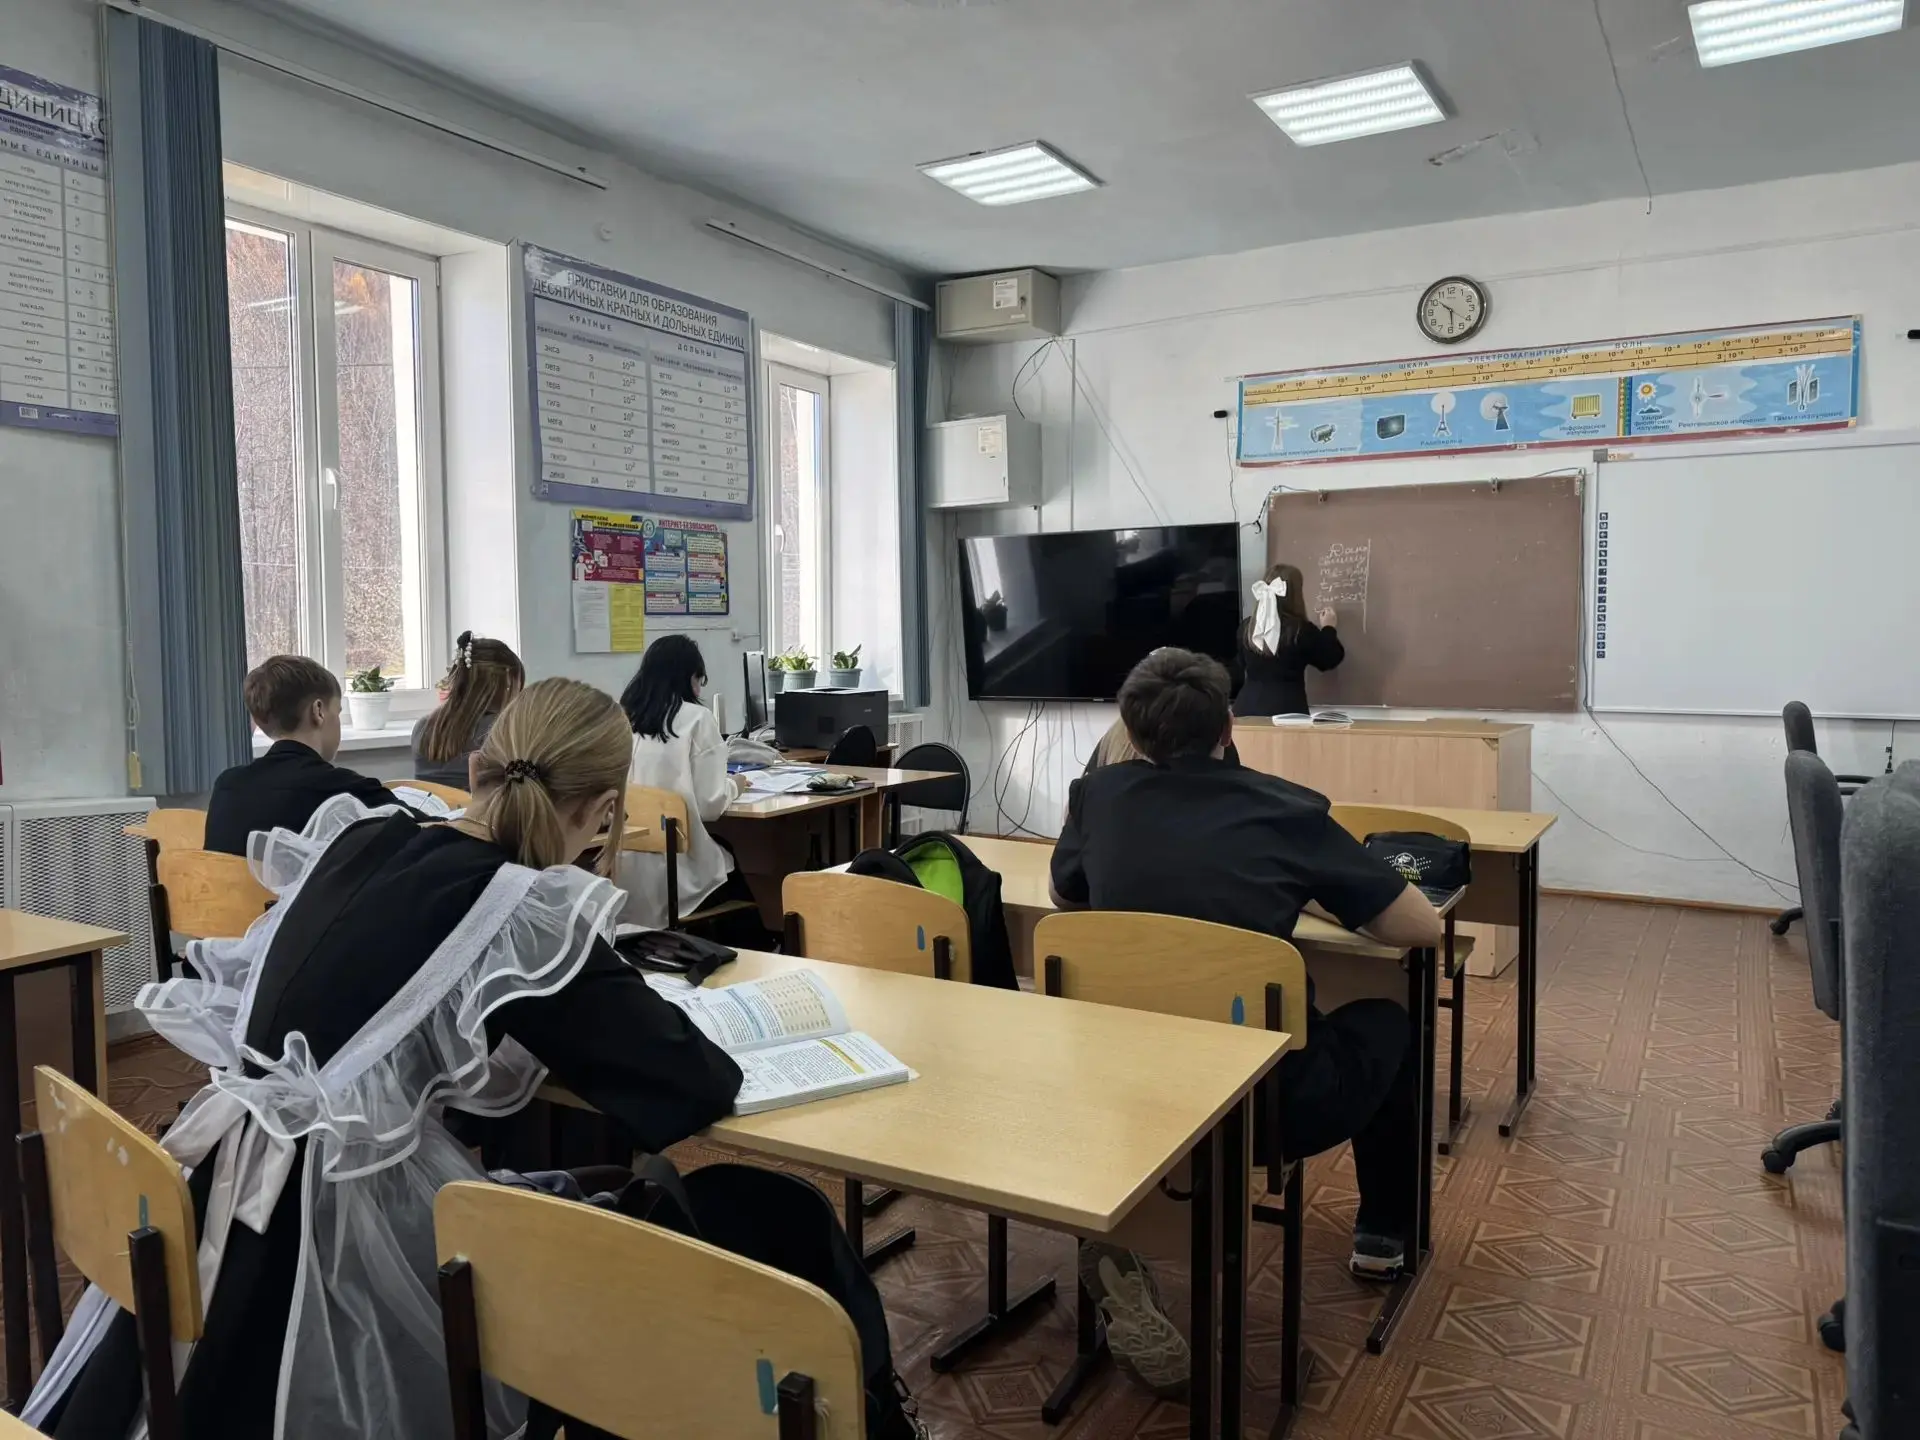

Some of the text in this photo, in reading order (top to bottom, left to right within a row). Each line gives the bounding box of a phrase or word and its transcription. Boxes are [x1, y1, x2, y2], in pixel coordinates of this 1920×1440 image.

[567, 271, 718, 327] ПРИСТАВКИ ДЛЯ ОБРАЗОВАНИЯ
[1438, 291, 1445, 299] 11
[1466, 295, 1472, 303] 2
[532, 278, 745, 350] ДЕСЯТИЧНЫХ КРАТНЫХ И ДОЛЬНЫХ ЕДИНИЦ
[1469, 304, 1475, 312] 3
[569, 313, 613, 332] КРАТНЫЕ
[1458, 322, 1465, 330] 5
[1398, 340, 1642, 369] ШКАЛА ЭЛЕКТРОМАГНИТНЫХ ВОЛН
